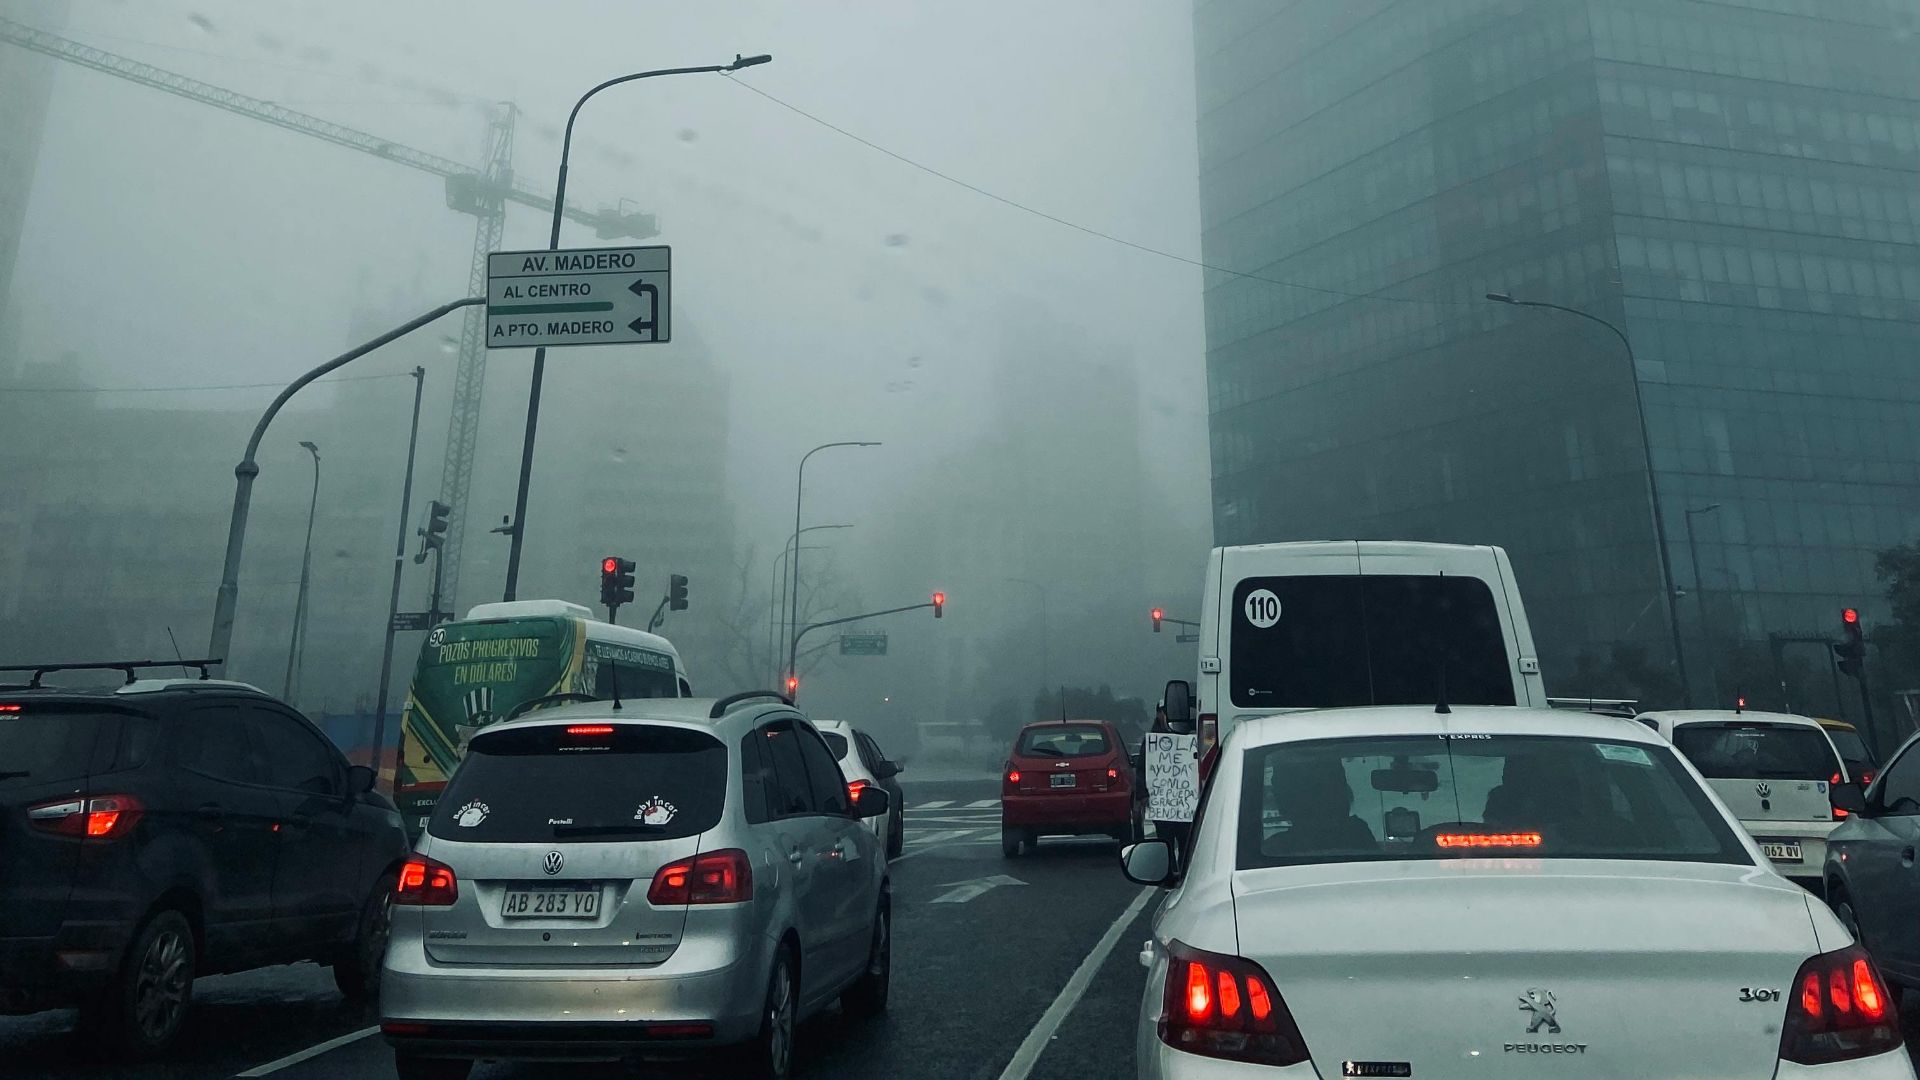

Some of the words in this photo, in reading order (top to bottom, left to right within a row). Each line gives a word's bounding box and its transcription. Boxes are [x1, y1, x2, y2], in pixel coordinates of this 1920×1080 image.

[522, 256, 548, 272] AV.
[555, 252, 636, 271] MADERO
[503, 286, 523, 298] AL
[527, 282, 591, 298] CENTRO
[493, 324, 504, 337] A
[508, 323, 543, 337] PTO.
[547, 320, 614, 335] MADERO
[1250, 596, 1278, 620] 110
[430, 630, 445, 646] 90
[439, 641, 471, 663] POZOS
[472, 638, 539, 661] PROGRESIVOS
[454, 665, 468, 685] EN
[1148, 734, 1198, 753] HOLA
[1159, 752, 1183, 764] ME
[453, 801, 472, 820] Baby
[634, 800, 651, 820] Baby
[653, 796, 664, 806] in
[664, 801, 678, 814] car
[506, 893, 529, 912] AB
[533, 893, 569, 913] 283
[575, 893, 595, 913] YO
[1739, 987, 1781, 1002] 301
[1503, 1043, 1587, 1054] PEUGEOT
